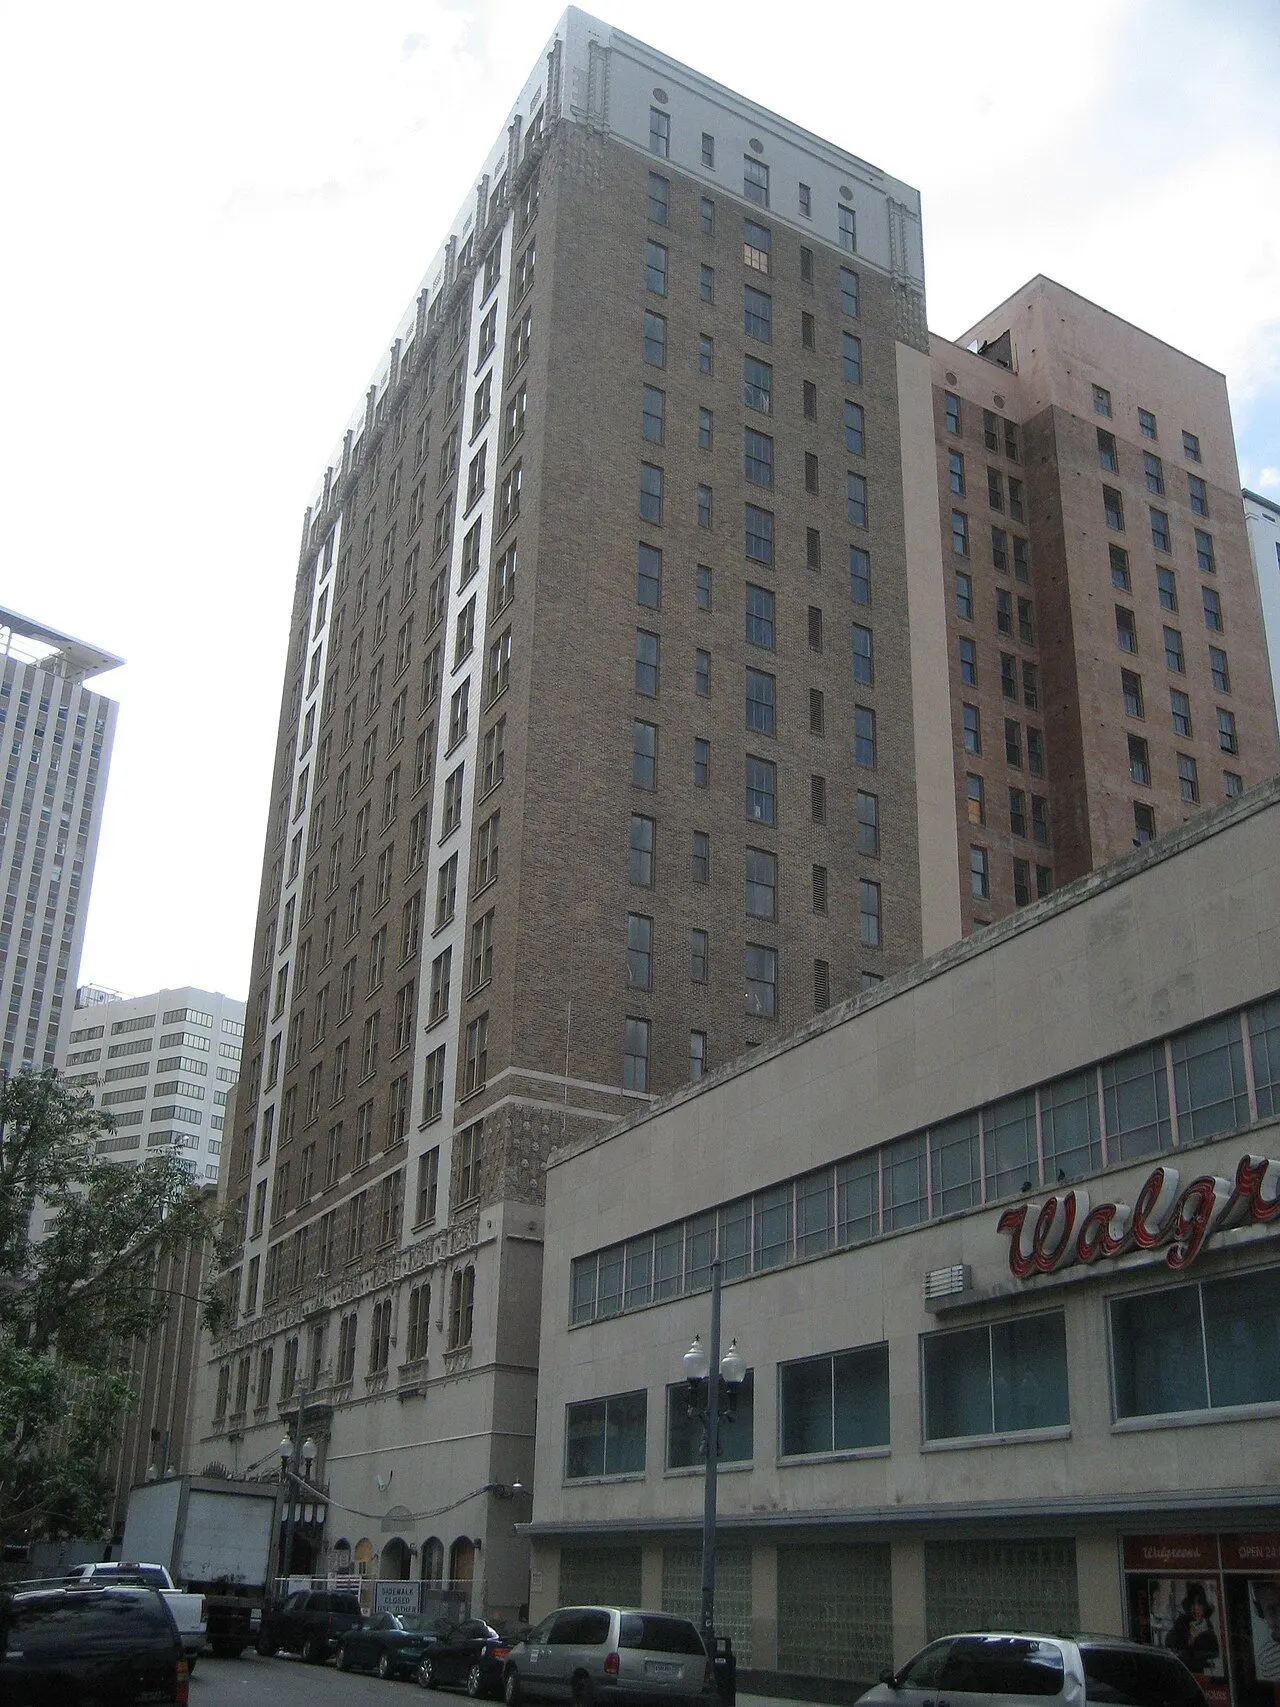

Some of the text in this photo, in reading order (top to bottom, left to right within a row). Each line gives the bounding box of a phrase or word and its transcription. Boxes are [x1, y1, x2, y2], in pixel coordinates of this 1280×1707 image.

[997, 1154, 1280, 1278] Walgr
[382, 1587, 413, 1596] SIDEWALK
[384, 1596, 410, 1604] CLOSED
